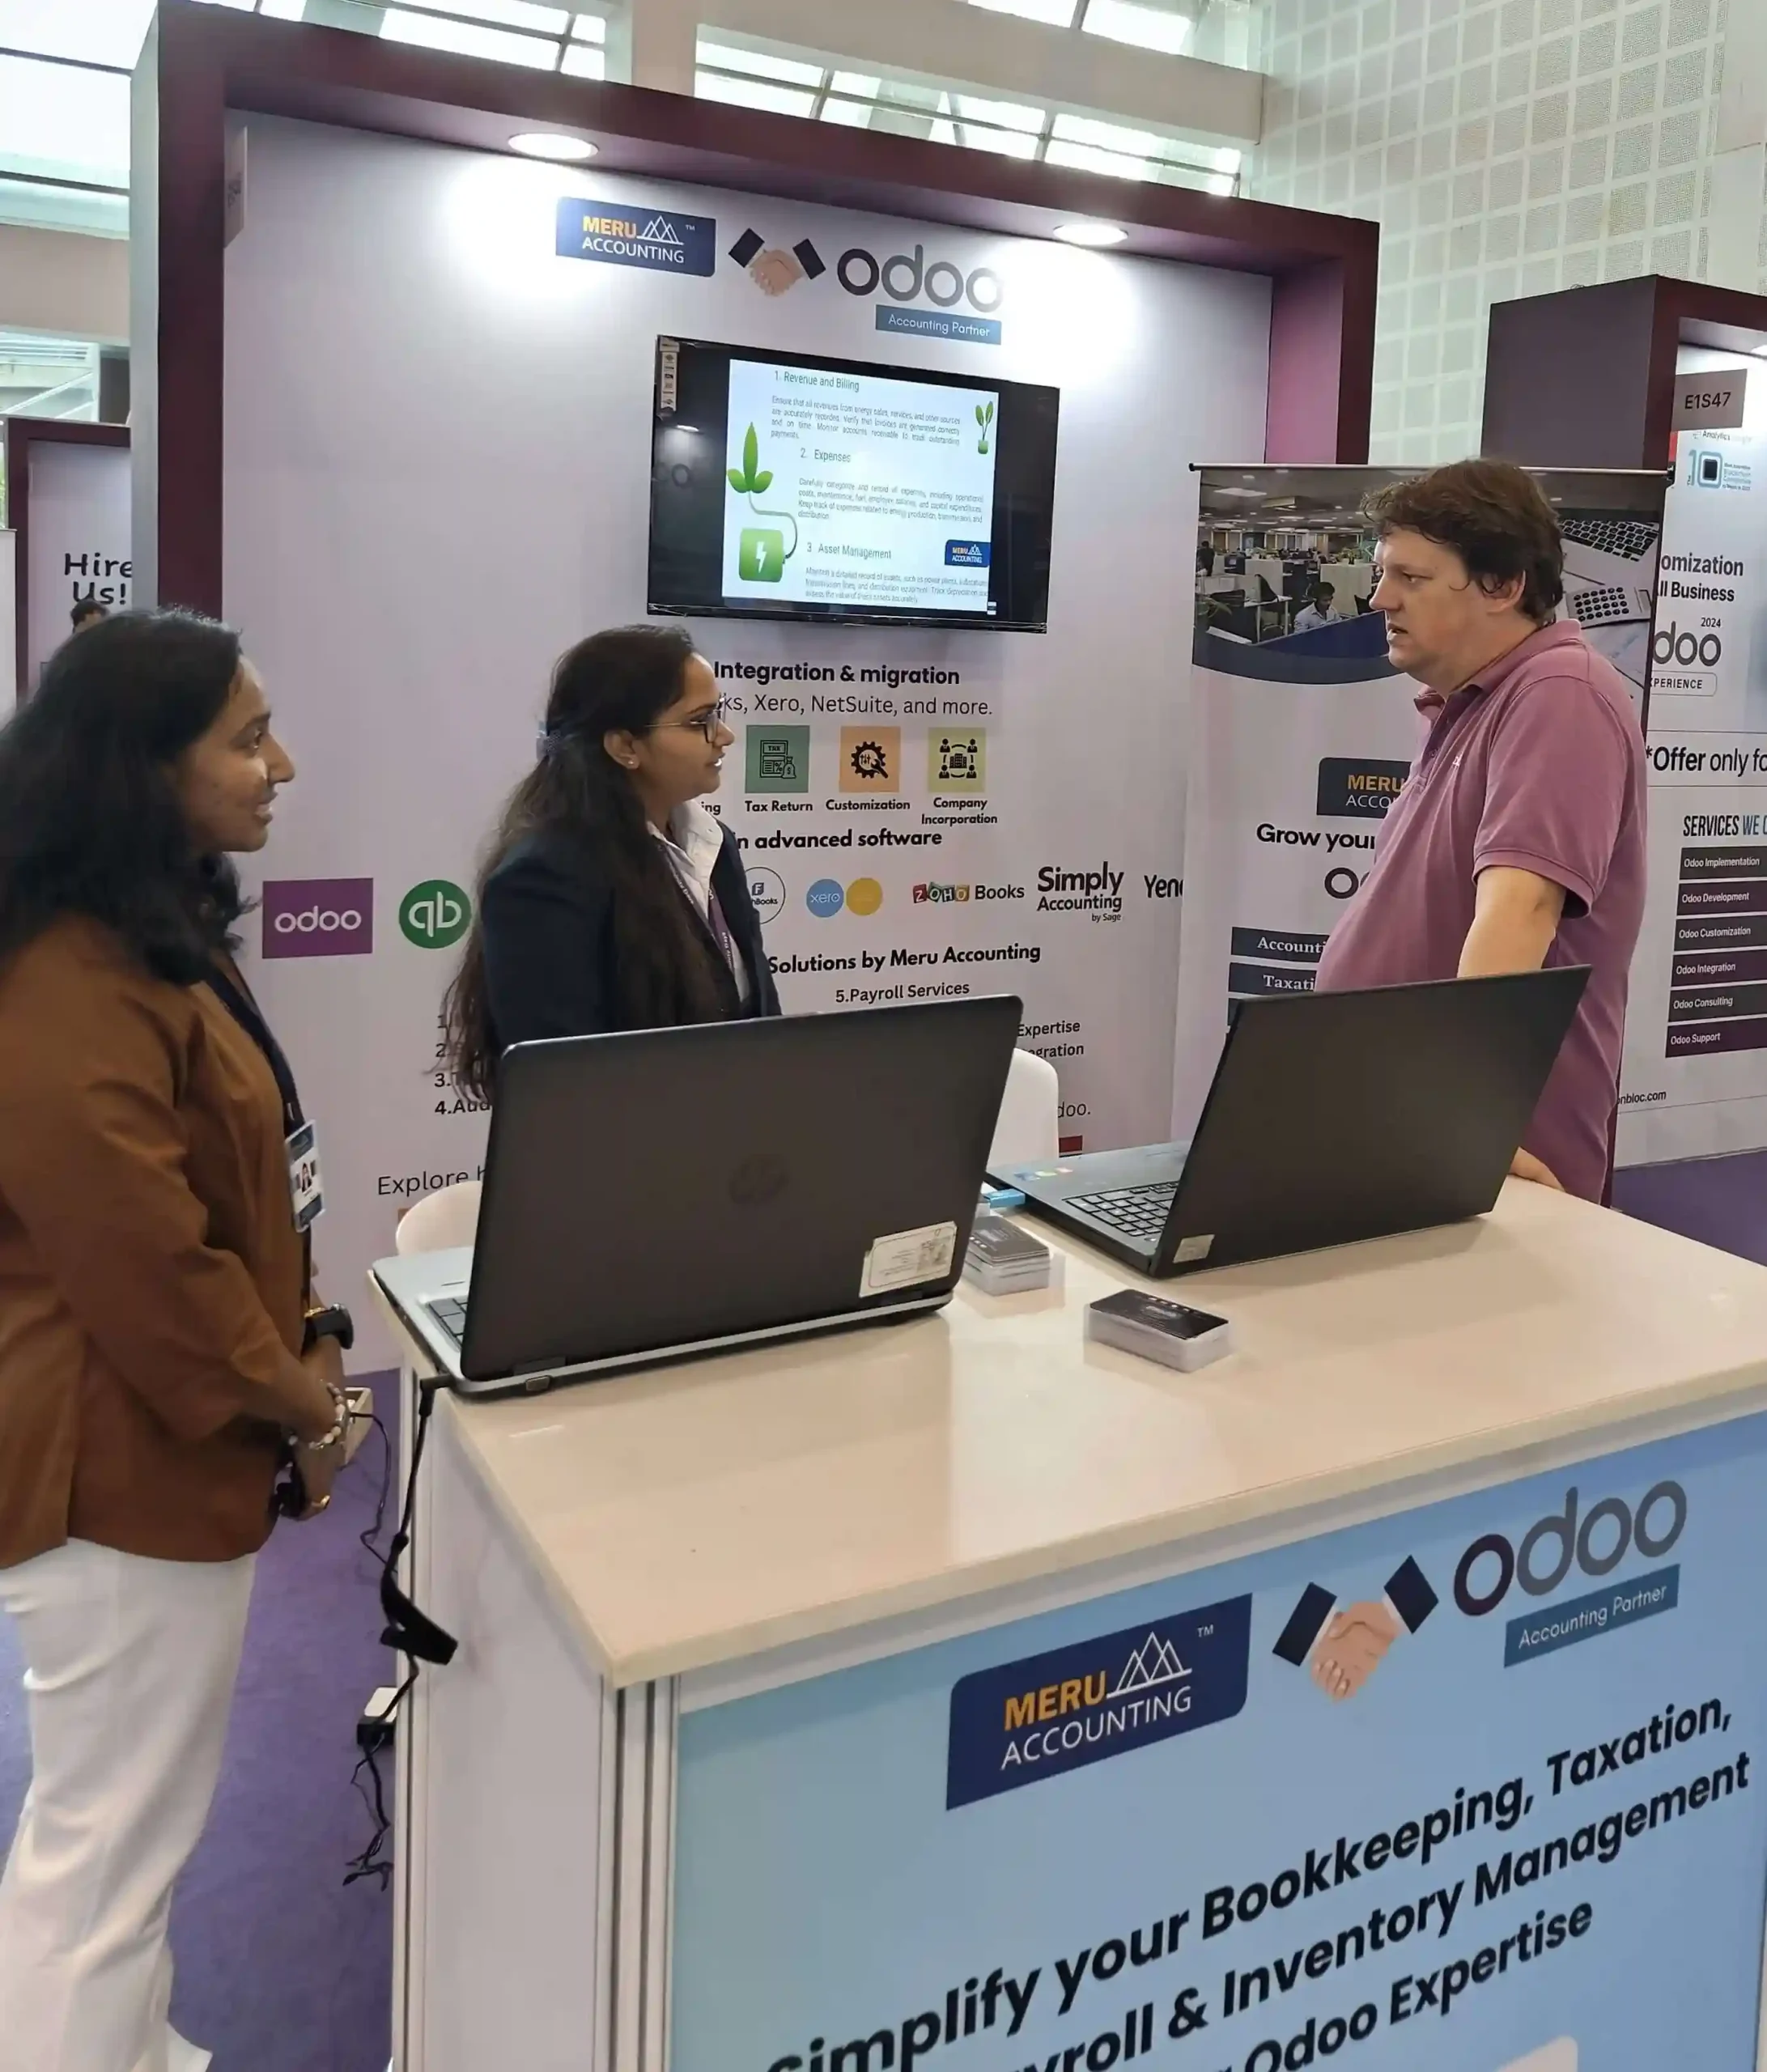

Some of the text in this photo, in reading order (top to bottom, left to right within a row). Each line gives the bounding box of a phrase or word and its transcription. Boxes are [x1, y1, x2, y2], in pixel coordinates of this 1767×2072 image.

[583, 216, 637, 239] MERU
[582, 237, 684, 263] ACCOUNTING
[837, 244, 1004, 312] odoo
[888, 313, 990, 338] Accounting Partner
[784, 372, 818, 385] Revenue
[820, 376, 835, 388] and
[836, 376, 860, 393] Billing
[1684, 392, 1731, 410] E1S47
[814, 449, 852, 463] Expenses
[818, 543, 840, 555] Asset
[842, 545, 892, 560] Management
[952, 555, 983, 564] ACCOUNTING
[65, 552, 132, 578] Hire
[1662, 553, 1744, 576] omization
[73, 581, 126, 605] Us!
[1671, 581, 1735, 602] Business
[1701, 618, 1721, 628] 2024
[715, 661, 960, 688] Integration & migration
[755, 694, 805, 715] Xero,
[811, 695, 898, 717] NetSuite,
[903, 696, 937, 715] and
[943, 700, 992, 715] more.
[1710, 748, 1748, 777] only
[1348, 774, 1404, 793] MERU
[745, 800, 813, 812] Tax Return
[826, 798, 911, 811] Customization
[933, 797, 988, 811] Company
[1345, 795, 1396, 809] ACCO
[921, 813, 998, 826] Incorporation
[1683, 815, 1739, 836] SERVICES
[1743, 815, 1761, 835] WE
[755, 829, 853, 849] advanced
[858, 827, 943, 847] software
[1256, 823, 1321, 847] Grow
[1684, 857, 1761, 868] Odoo Implementation
[1037, 861, 1124, 897] Simply
[810, 892, 840, 904] xero
[913, 881, 1026, 904] ZOHO Books
[1037, 894, 1123, 912] Accounting
[1682, 892, 1749, 903] Odoo Development
[274, 905, 362, 933] odoo
[1092, 914, 1121, 923] by Sage
[1679, 927, 1751, 939] Odoo Customization
[768, 945, 1041, 974] Solutions by Meru Accounting
[1676, 962, 1735, 974] Odoo Integration
[835, 982, 970, 1004] 5.Payroll Services
[1673, 996, 1733, 1009] Odoo Consulting
[1017, 1021, 1081, 1038] Expertise
[1671, 1033, 1721, 1045] Odoo Support
[379, 1169, 469, 1197] Explore
[1454, 1480, 1687, 1616] odoo
[1518, 1586, 1667, 1650] Accounting Partner
[1004, 1624, 1213, 1732] MERU TM
[1000, 1685, 1192, 1770] ACCOUNTING
[1054, 1909, 1190, 2016] your
[1202, 1777, 1535, 1941] Bookkeeping,
[1547, 1698, 1731, 1795] Taxation,
[1168, 1988, 1209, 2040] &
[1223, 1879, 1464, 2019] Inventory
[1473, 1751, 1750, 1906] Management
[1390, 1902, 1593, 2025] Expertise
